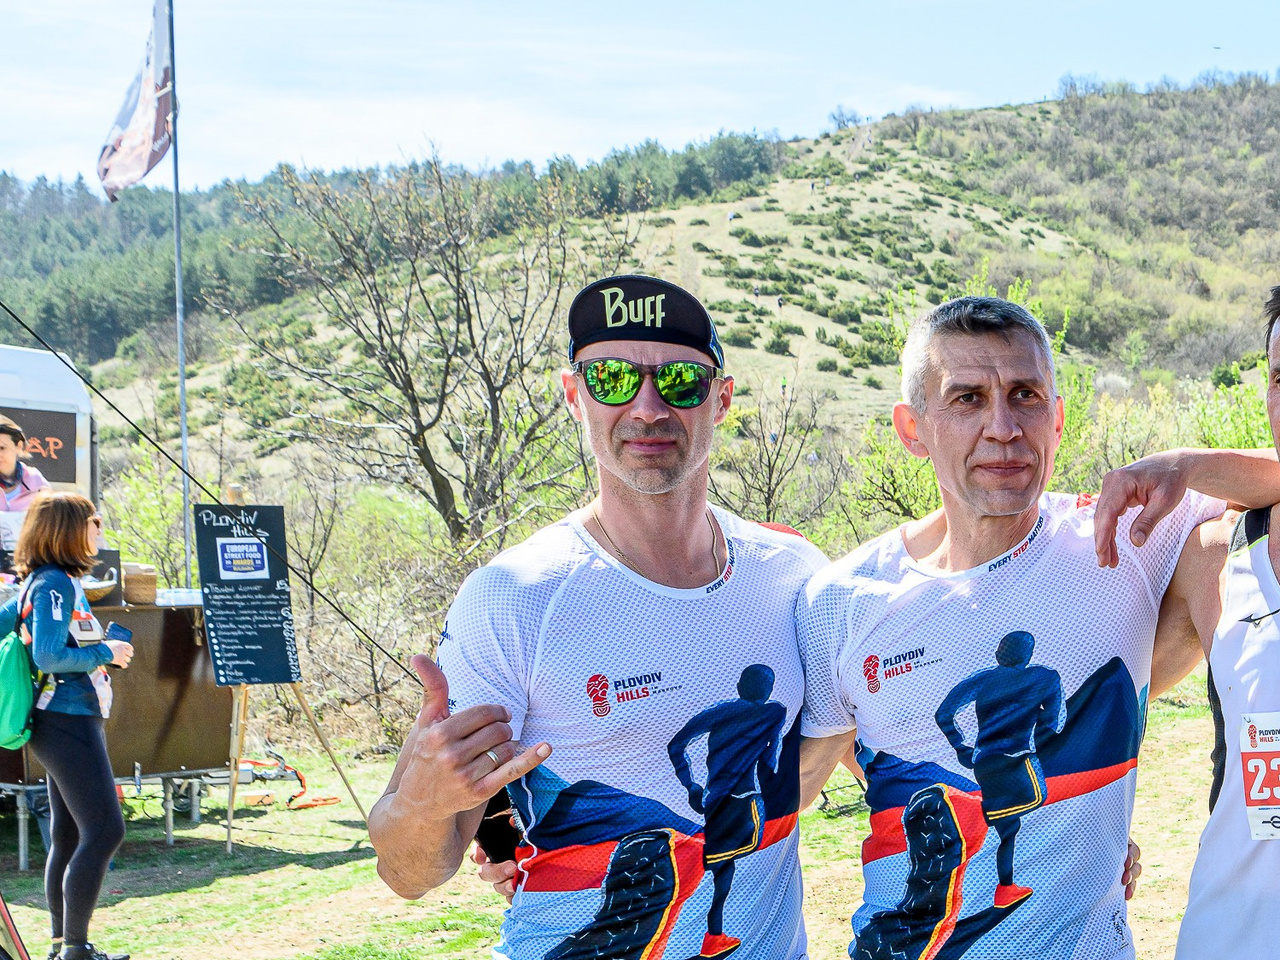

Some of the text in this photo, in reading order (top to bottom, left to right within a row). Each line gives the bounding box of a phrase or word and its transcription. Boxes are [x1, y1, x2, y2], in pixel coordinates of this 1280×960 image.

[599, 286, 666, 328] Buff
[225, 544, 258, 553] EUROPEAN
[987, 554, 1013, 573] EVERY
[1013, 540, 1029, 559] STEP
[705, 578, 725, 594] EVERY
[882, 646, 926, 669] PLOVDIV
[884, 662, 913, 680] HILLS
[613, 671, 662, 690] PLOVDIV
[616, 687, 650, 703] HILLS
